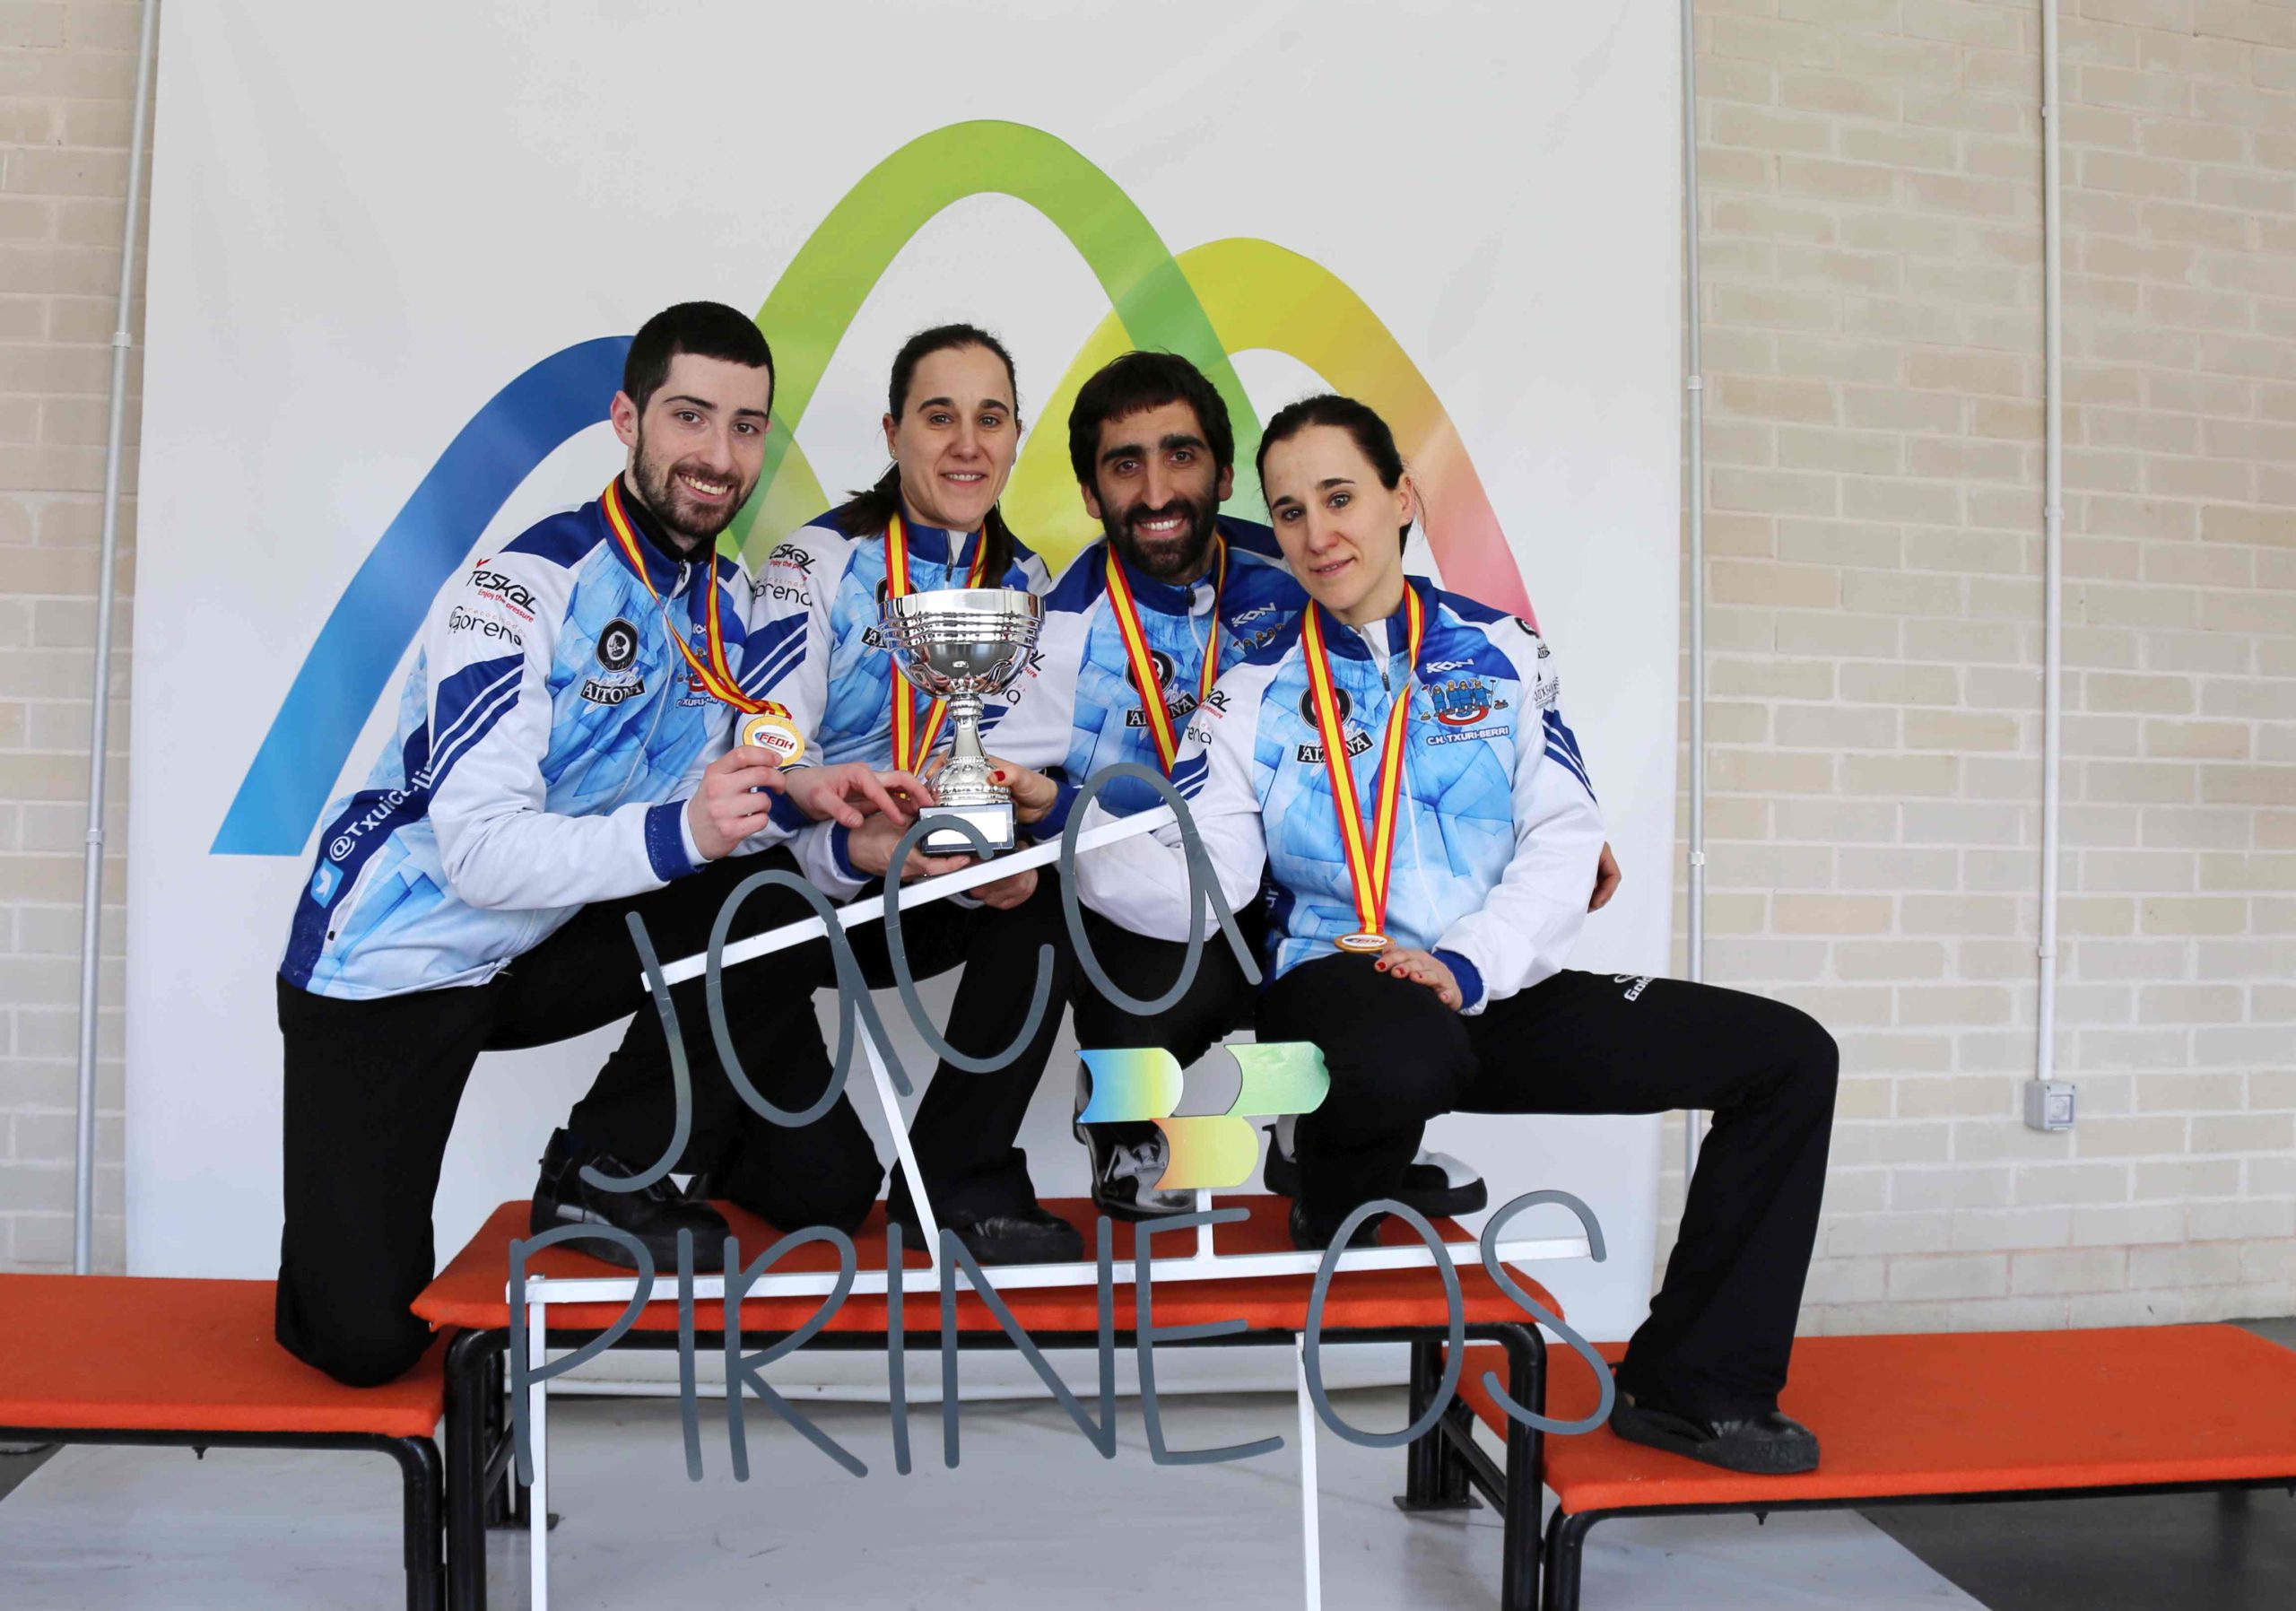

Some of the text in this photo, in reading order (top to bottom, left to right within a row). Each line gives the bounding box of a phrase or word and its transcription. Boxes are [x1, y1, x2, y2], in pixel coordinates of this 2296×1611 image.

[759, 732, 796, 751] FEDH
[1447, 727, 1509, 743] TXURI-BERRI
[509, 1189, 1615, 1485] PIRINEOS
